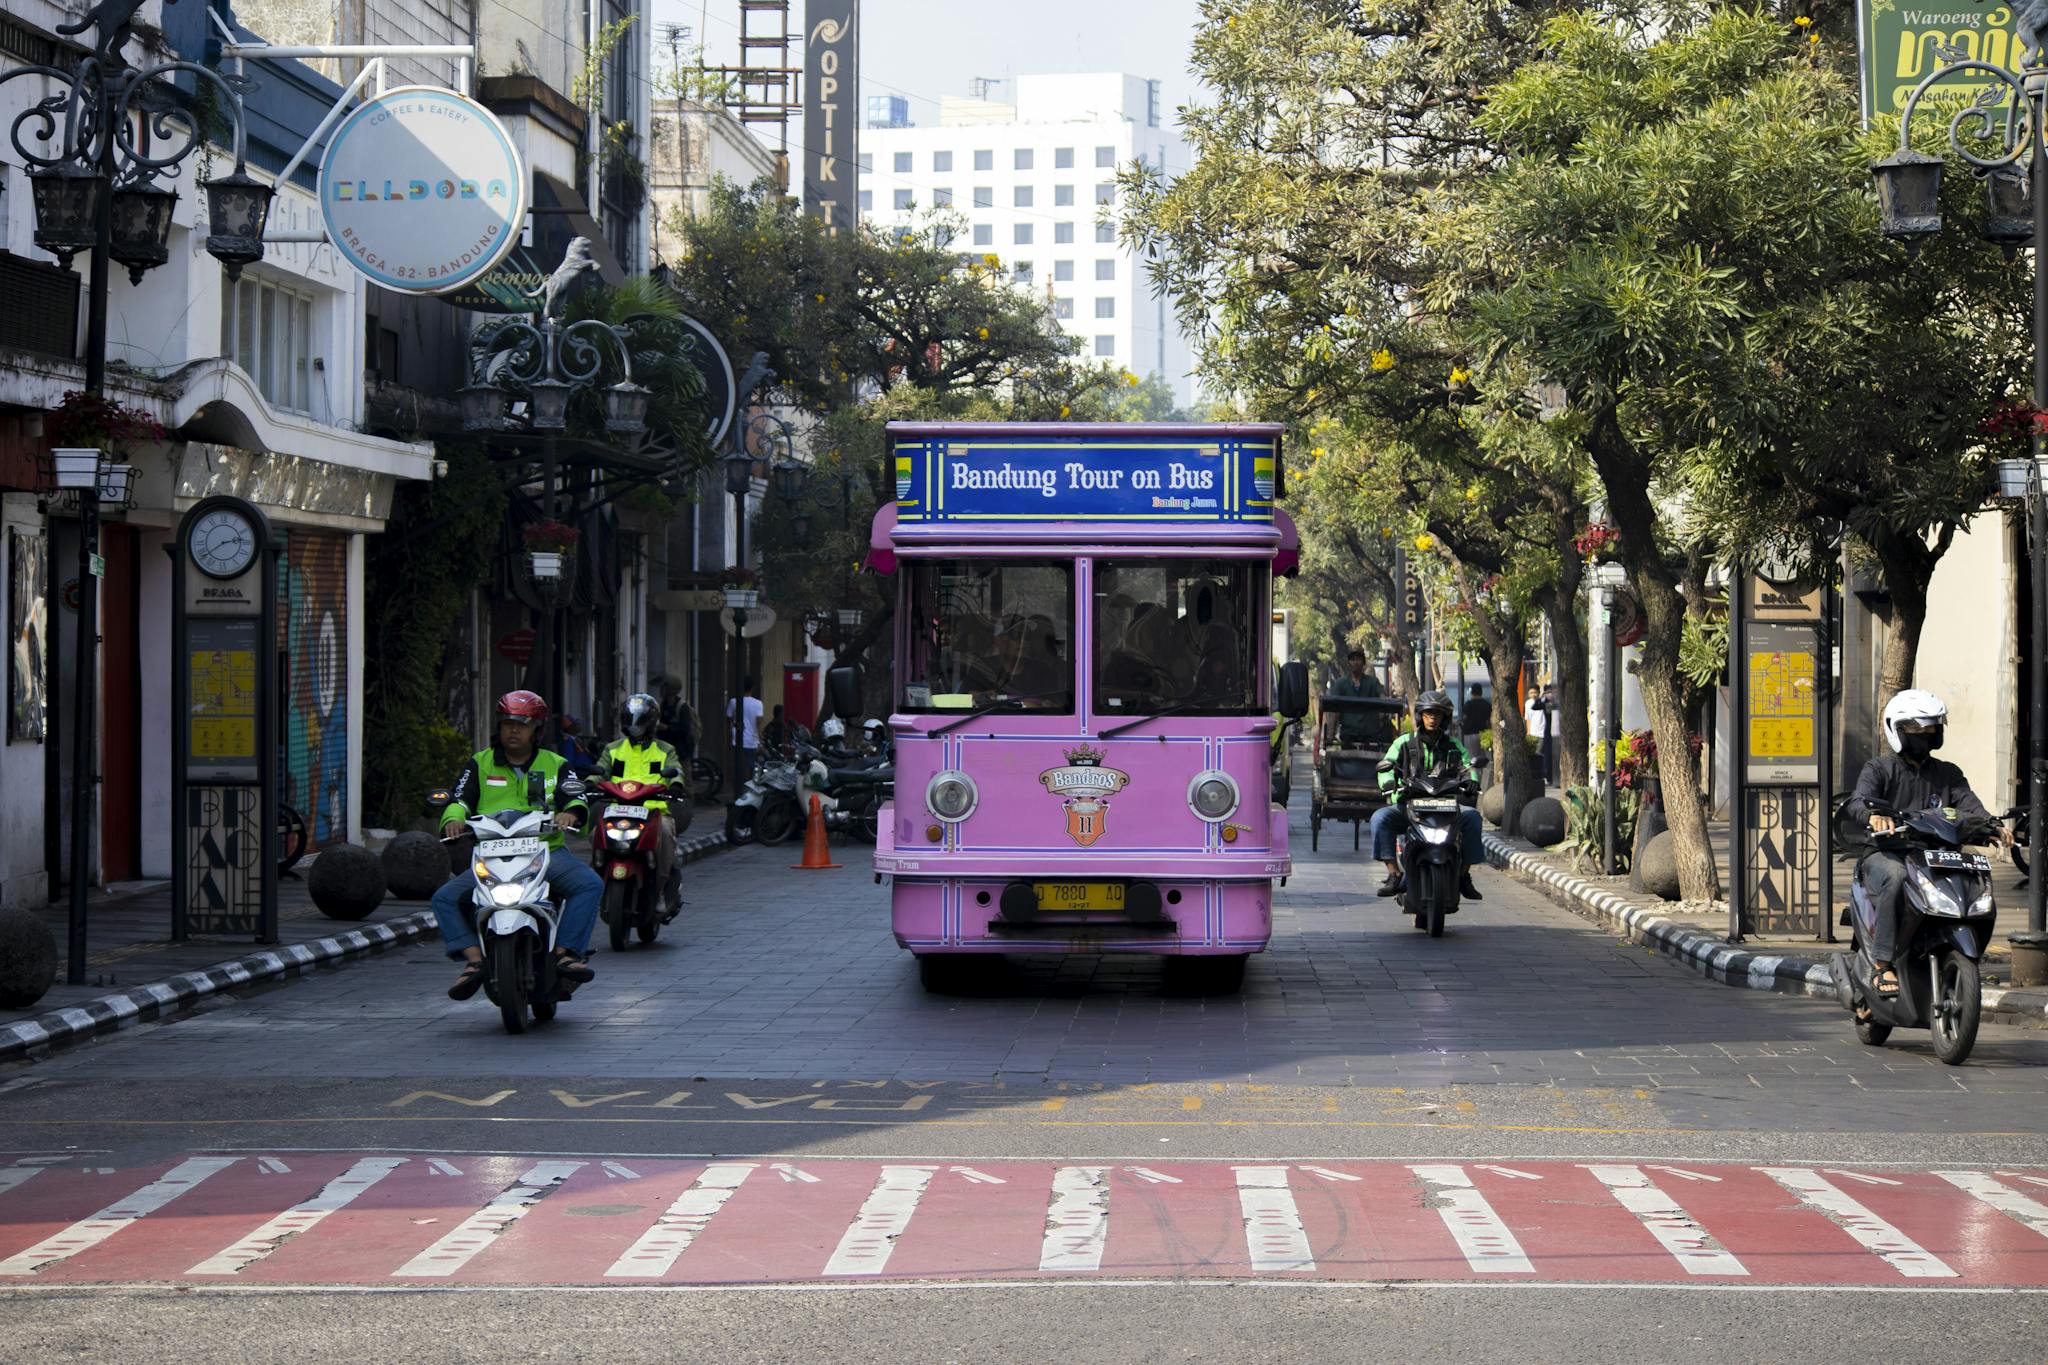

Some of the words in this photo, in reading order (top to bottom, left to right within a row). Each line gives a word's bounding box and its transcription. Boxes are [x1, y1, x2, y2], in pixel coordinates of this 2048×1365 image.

[1902, 9, 1982, 28] Waroeng
[370, 104, 413, 126] COFFEE
[417, 104, 424, 113] &
[430, 105, 470, 124] EATERY
[819, 50, 838, 182] OPTIK
[341, 227, 385, 272] BRAGA
[428, 224, 498, 278] BANDUNG
[951, 462, 1057, 497] Bandung
[1064, 462, 1124, 490] Tour
[1131, 469, 1161, 490] on
[1169, 462, 1214, 490] Bus
[1152, 496, 1190, 510] Bandung
[1405, 546, 1417, 623] RAGA
[1052, 768, 1117, 788] Bandros
[897, 859, 920, 870] Tram
[1938, 852, 1963, 861] 2532
[1053, 885, 1086, 901] 7880
